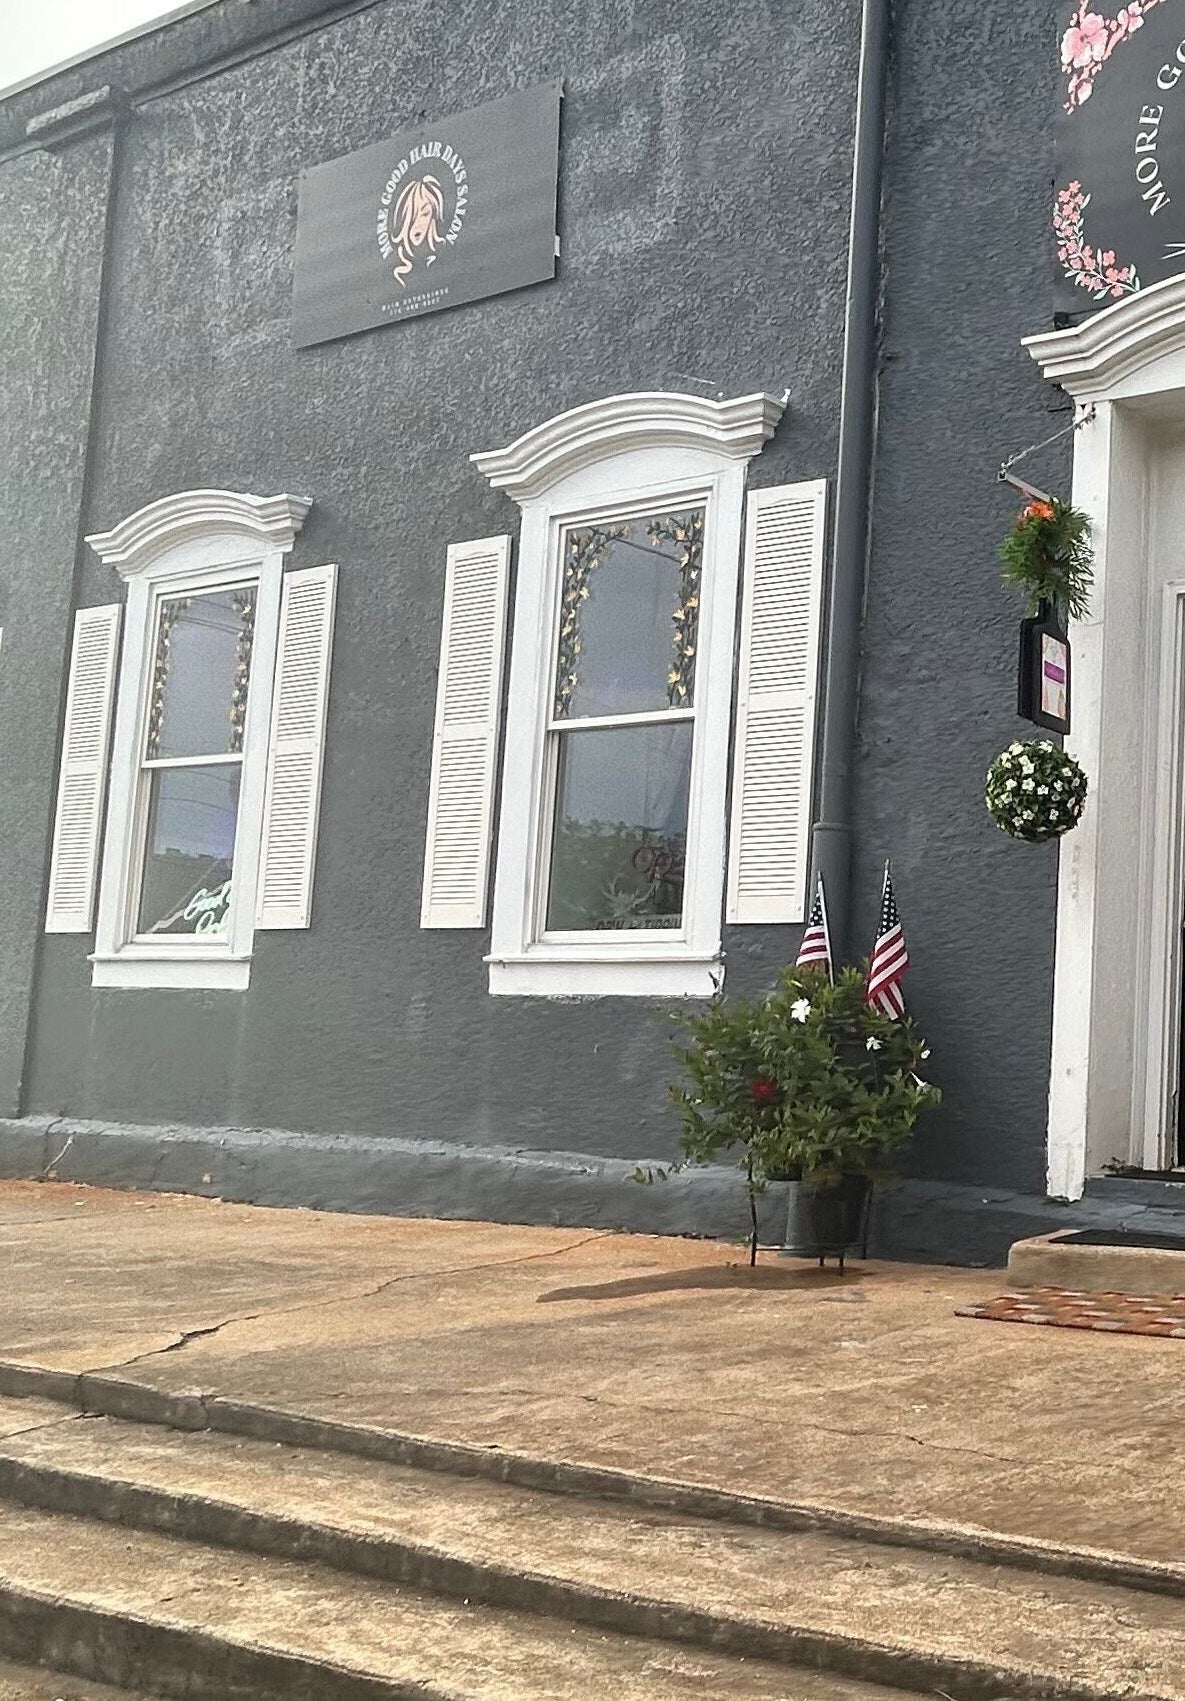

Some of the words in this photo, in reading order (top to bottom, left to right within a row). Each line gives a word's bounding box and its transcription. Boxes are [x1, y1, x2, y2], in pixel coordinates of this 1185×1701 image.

[409, 141, 443, 166] HAIR
[441, 145, 468, 185] DAYS
[1134, 104, 1173, 217] MORE
[381, 159, 409, 206] GOOD
[376, 208, 395, 259] MORE
[446, 184, 469, 246] SALON
